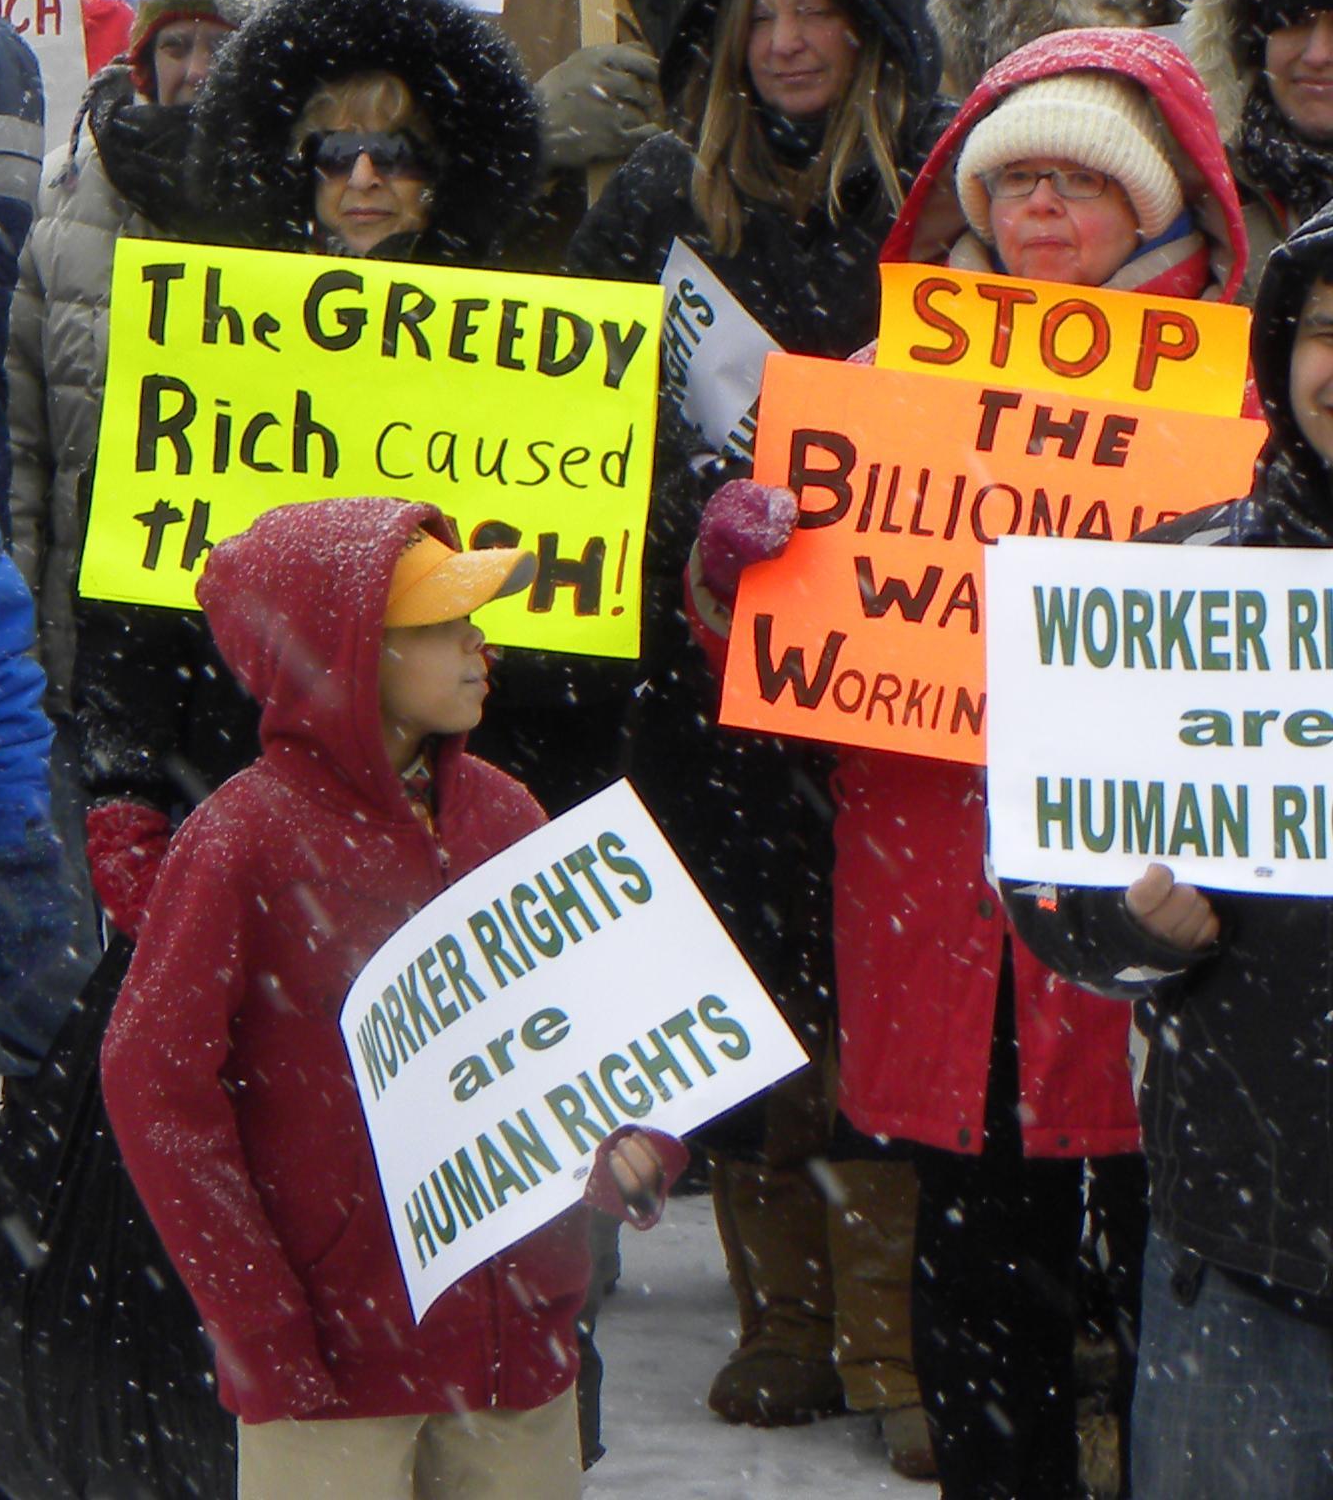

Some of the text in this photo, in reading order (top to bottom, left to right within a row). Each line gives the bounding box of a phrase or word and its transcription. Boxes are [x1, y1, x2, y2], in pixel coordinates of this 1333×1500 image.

[139, 261, 647, 390] The GREEDY
[907, 276, 1200, 392] STOP
[135, 373, 338, 479] Rich
[375, 420, 635, 489] caused
[974, 388, 1138, 467] THE
[132, 498, 214, 572] th
[1032, 585, 1270, 671] WORKER
[1178, 706, 1333, 748] are
[1035, 775, 1333, 859] HUMAN RI
[356, 830, 653, 1103] WORKER RIGHTS
[448, 1005, 572, 1103] are
[404, 993, 752, 1270] HUMAN RIGHTS
